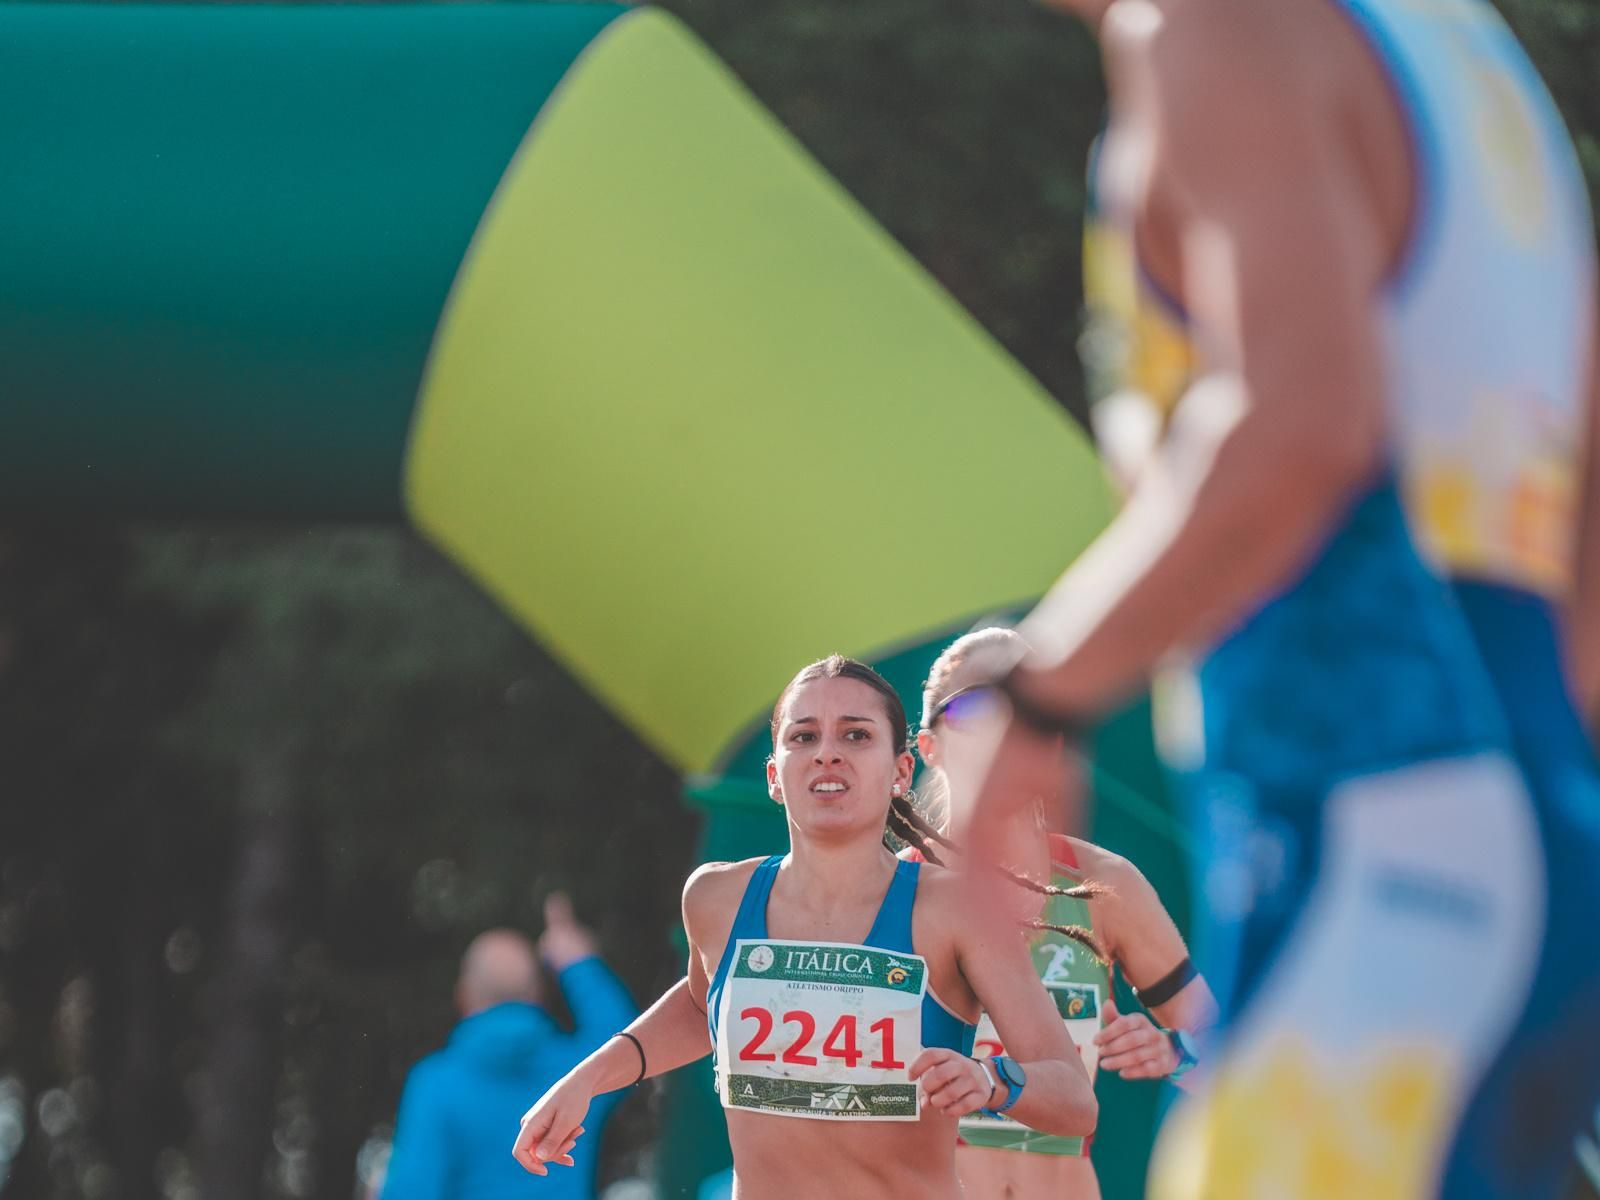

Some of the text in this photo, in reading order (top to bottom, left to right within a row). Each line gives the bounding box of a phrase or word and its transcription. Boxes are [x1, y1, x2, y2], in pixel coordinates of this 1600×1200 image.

[785, 948, 873, 974] ITÁLICA
[787, 983, 864, 994] ATLETISMO ORIPPO
[739, 1007, 905, 1070] 2241
